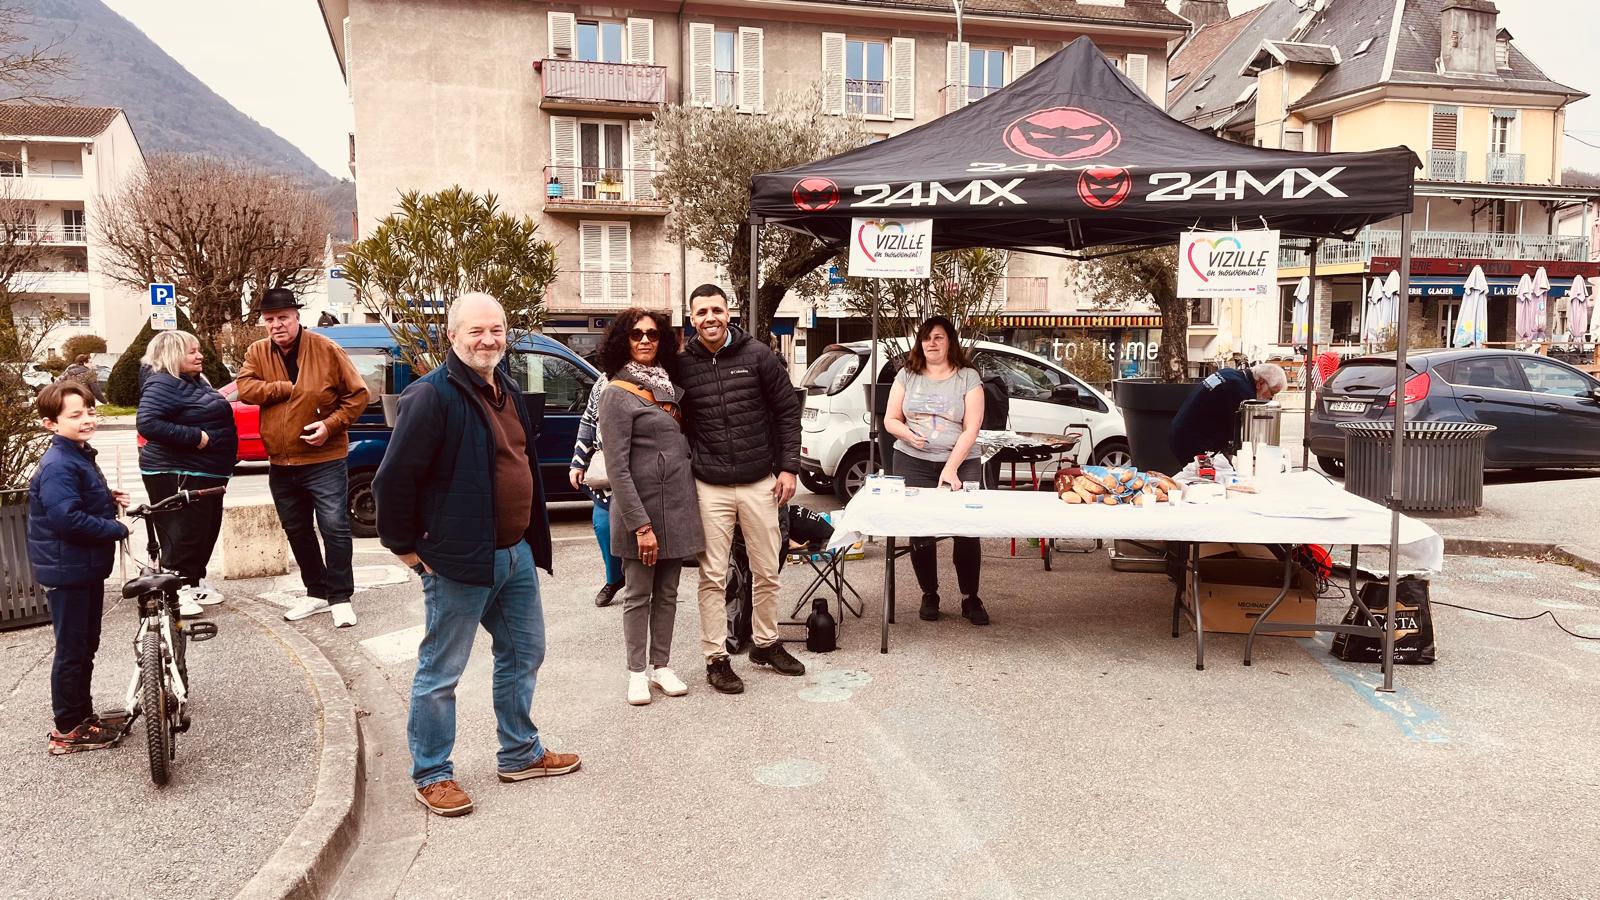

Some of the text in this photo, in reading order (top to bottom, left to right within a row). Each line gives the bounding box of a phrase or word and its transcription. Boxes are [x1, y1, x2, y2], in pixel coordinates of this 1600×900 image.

[1145, 166, 1349, 201] 24MX
[850, 178, 1028, 207] 24MX
[876, 234, 925, 250] VIZILLE
[1208, 250, 1269, 268] VIZILLE
[1206, 269, 1216, 277] en
[156, 288, 168, 302] P
[1427, 287, 1454, 295] GLACIER
